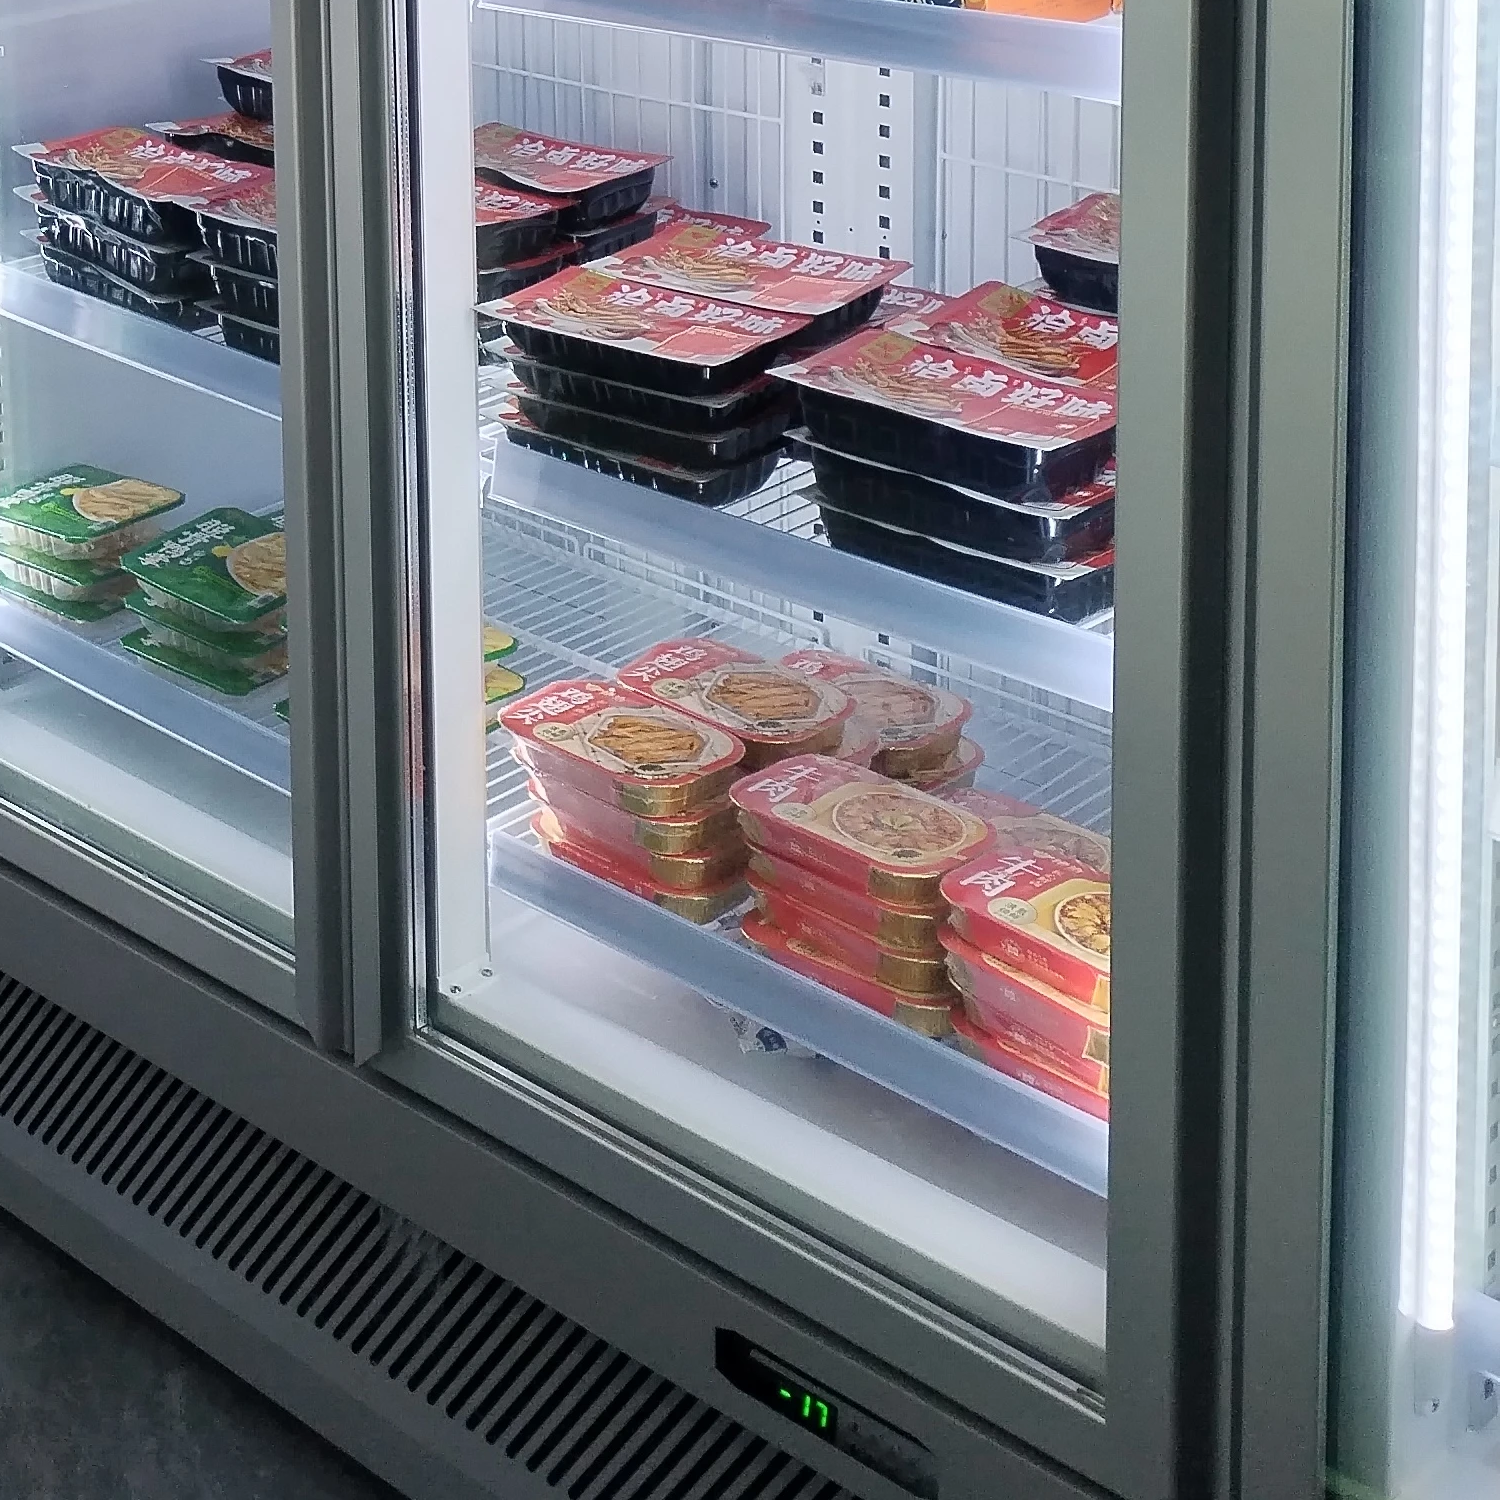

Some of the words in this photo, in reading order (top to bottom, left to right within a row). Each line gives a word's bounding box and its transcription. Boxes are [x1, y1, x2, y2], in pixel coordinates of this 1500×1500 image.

[505, 687, 594, 725] 鸡翅尖
[746, 764, 822, 800] 牛肉
[959, 856, 1045, 897] 牛肉
[779, 1388, 828, 1428] -17
